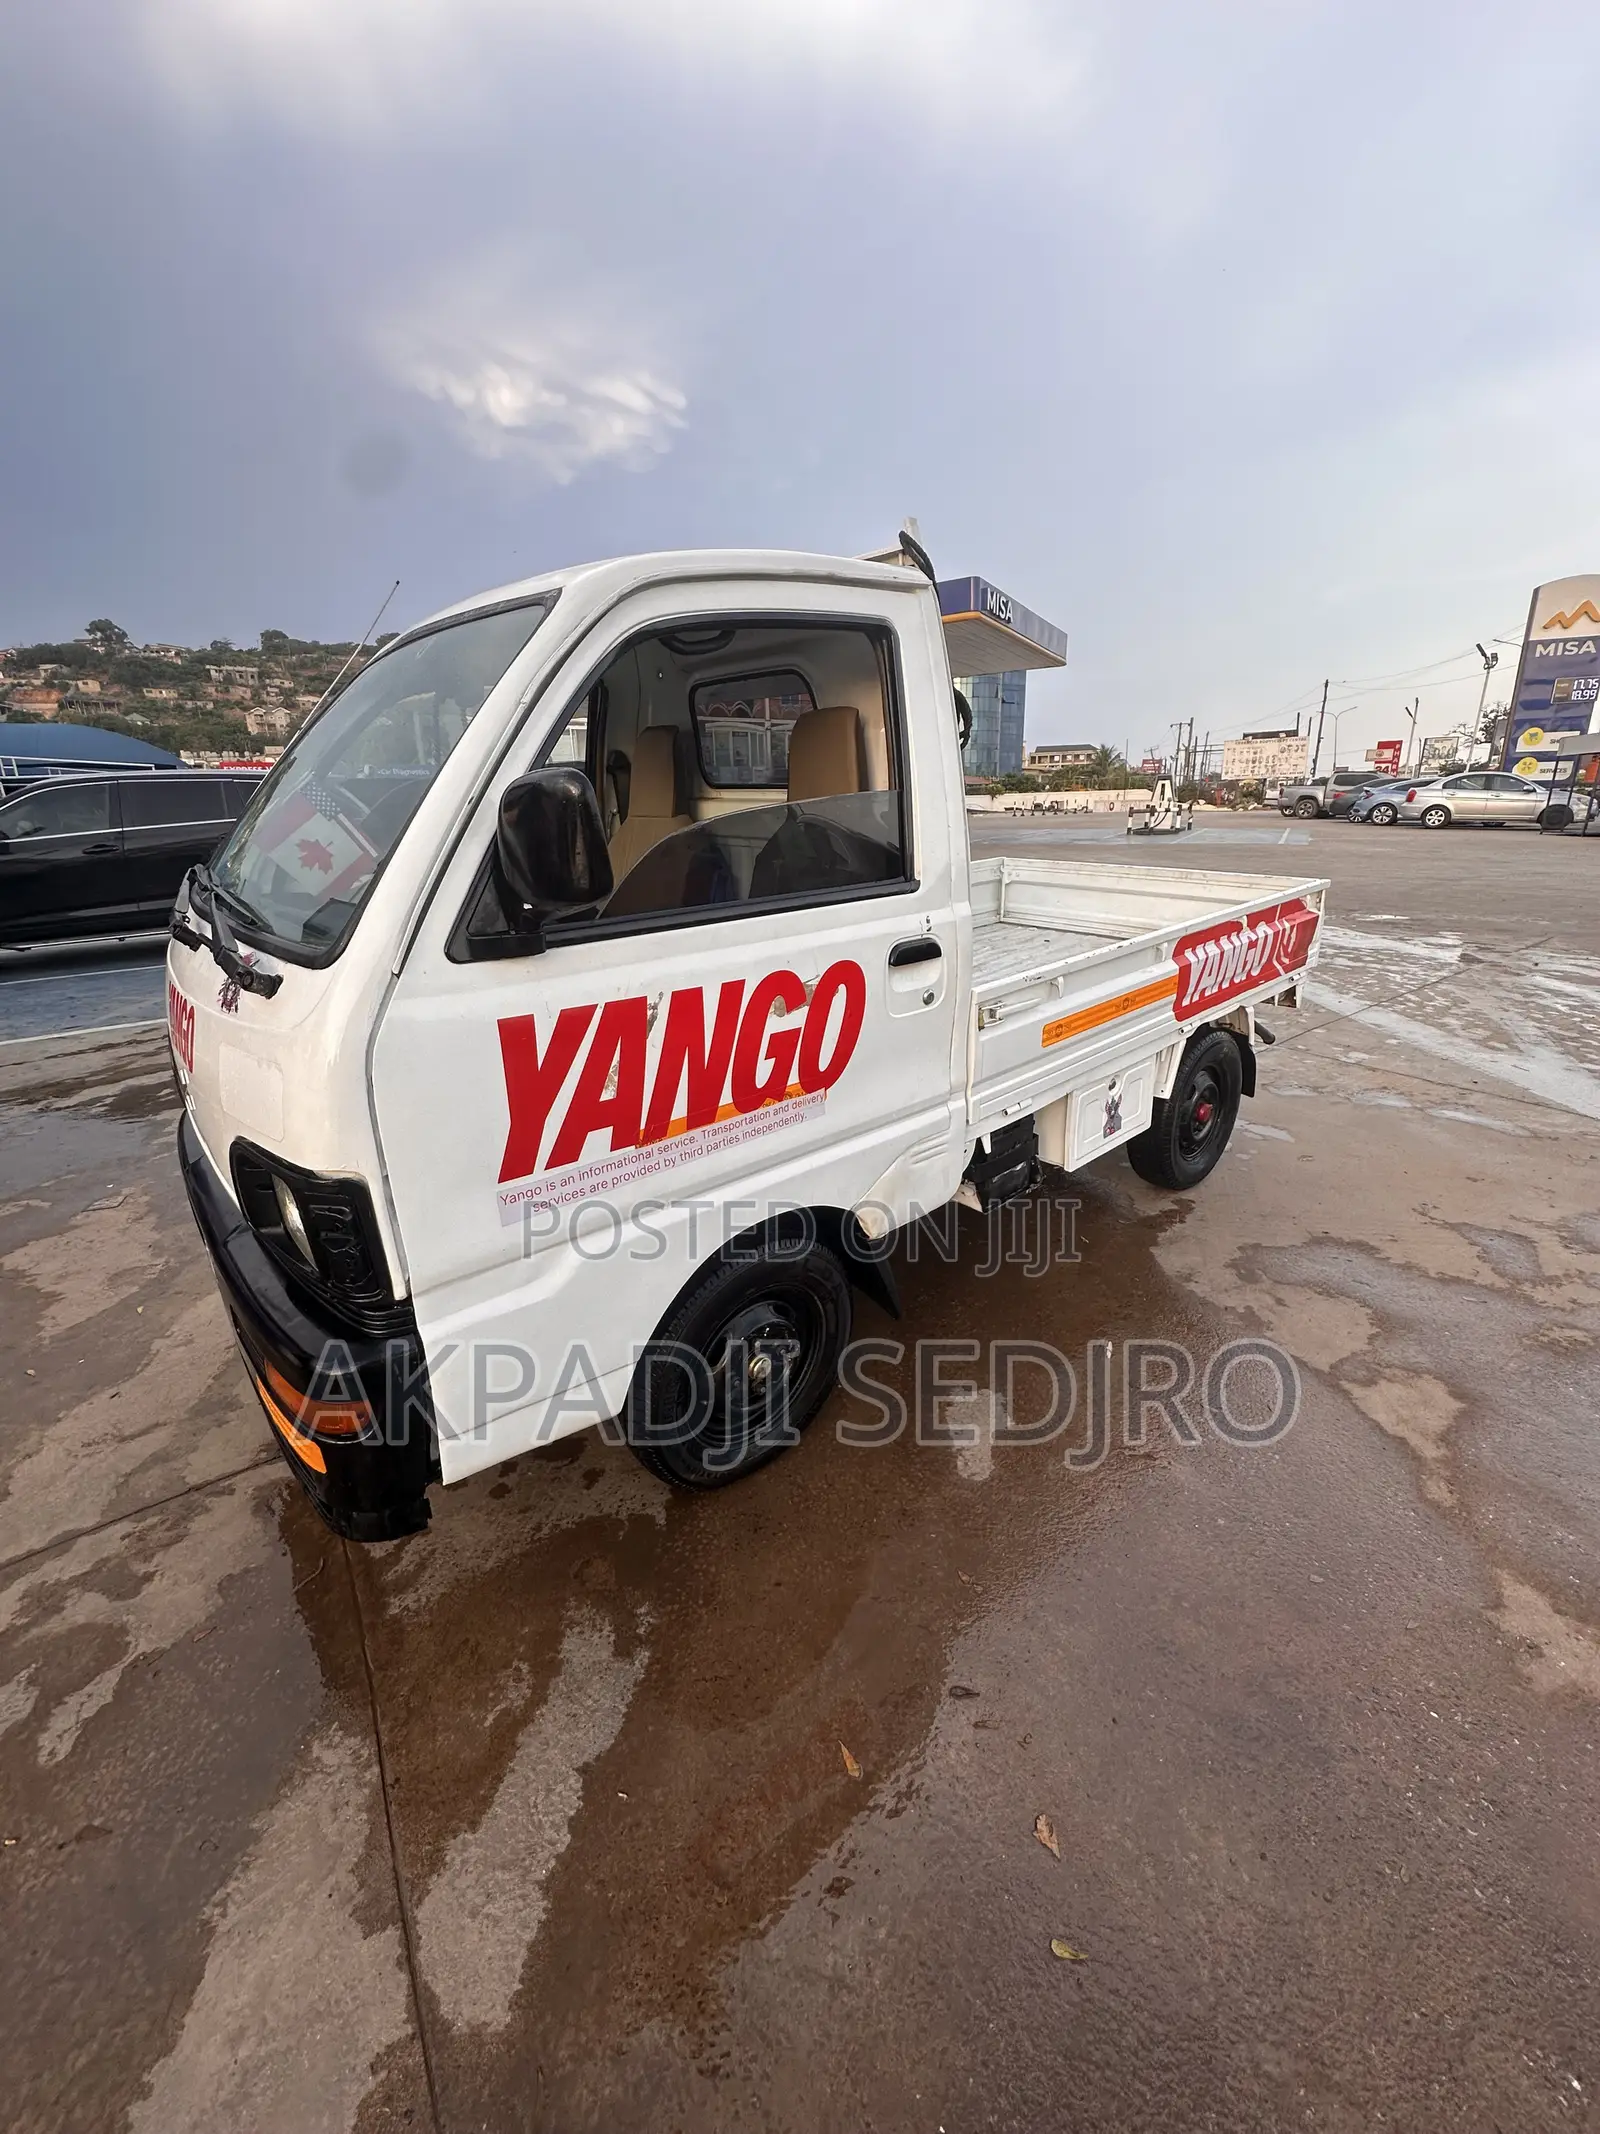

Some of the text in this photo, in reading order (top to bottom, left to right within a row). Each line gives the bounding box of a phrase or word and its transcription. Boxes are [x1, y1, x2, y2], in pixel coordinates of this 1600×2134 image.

[987, 587, 1013, 623] MISA
[1535, 640, 1597, 658] MISA
[1182, 920, 1274, 1008] YANGO
[497, 959, 867, 1184] YANGO
[500, 1186, 543, 1206] Yango
[546, 1181, 557, 1192] is
[560, 1174, 576, 1187] an
[579, 1151, 654, 1182] informational
[657, 1134, 699, 1155] service.
[701, 1109, 771, 1140] Transportation
[773, 1103, 790, 1117] and
[792, 1092, 826, 1110] delivery
[532, 1112, 808, 1213] services are provided by third parties independently.
